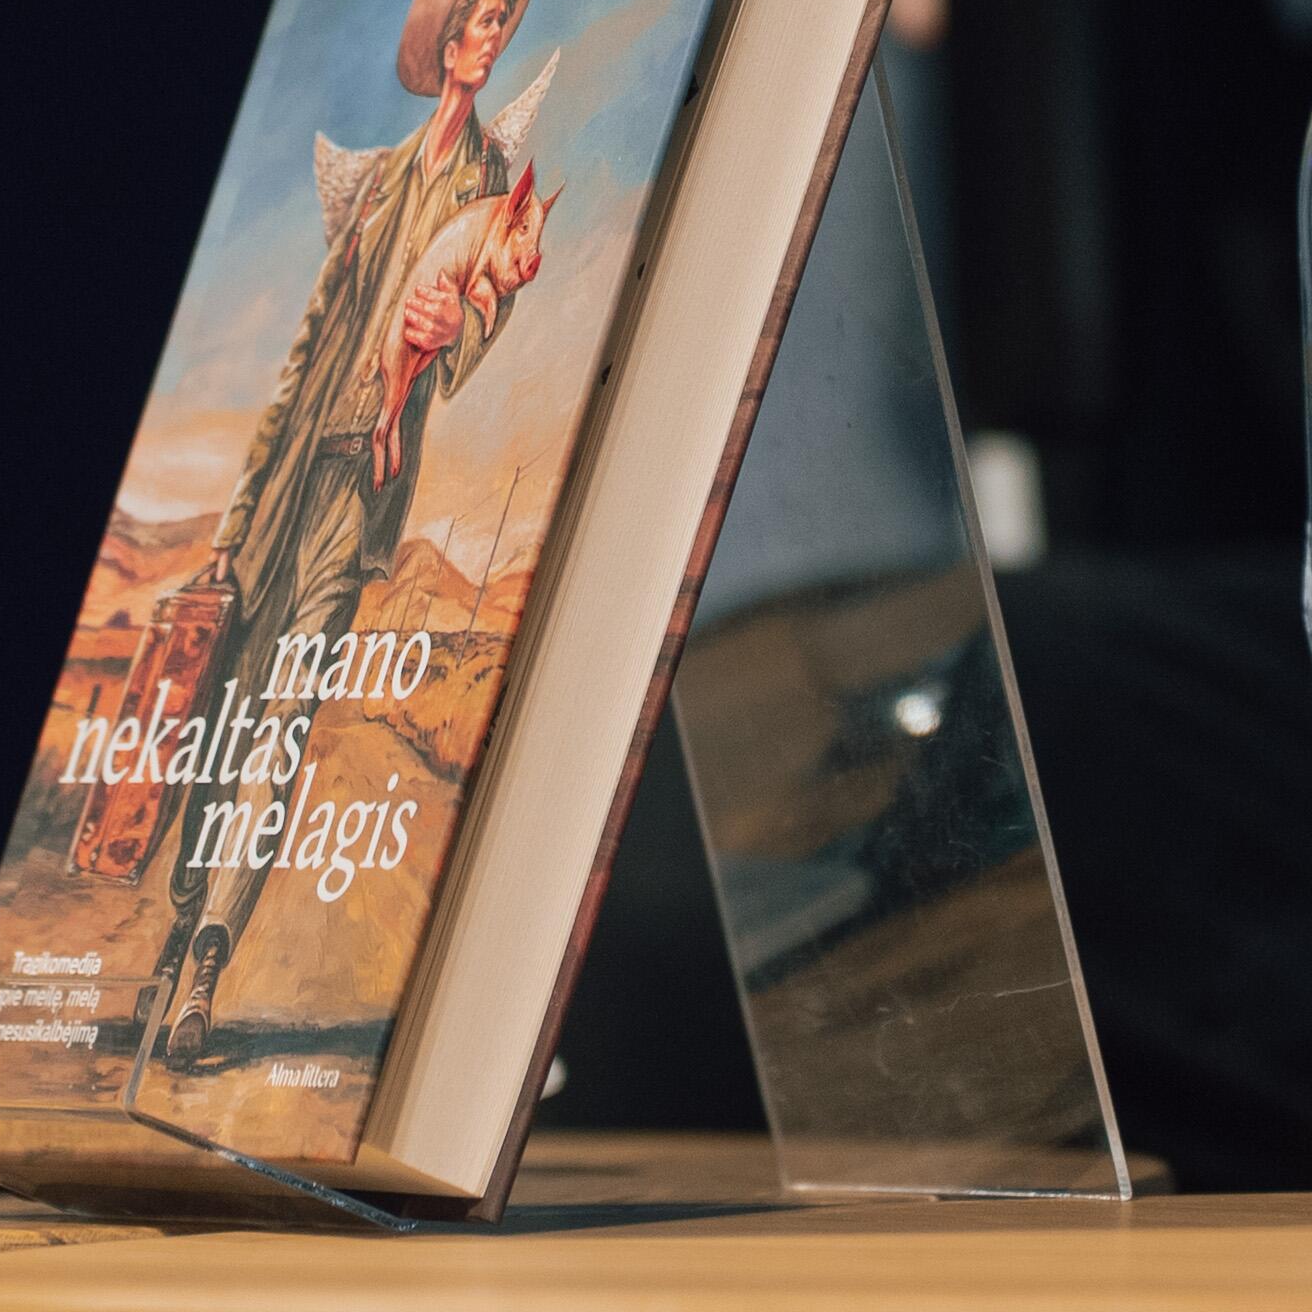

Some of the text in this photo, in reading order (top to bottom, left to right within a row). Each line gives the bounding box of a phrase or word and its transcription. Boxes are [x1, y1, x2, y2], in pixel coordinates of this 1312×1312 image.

[259, 630, 431, 702] mano
[58, 678, 311, 786] nekaltas
[186, 762, 419, 903] melagis
[12, 951, 102, 977] Tragikomedija
[66, 985, 101, 1014] melą
[265, 1062, 340, 1088] Alma littera
